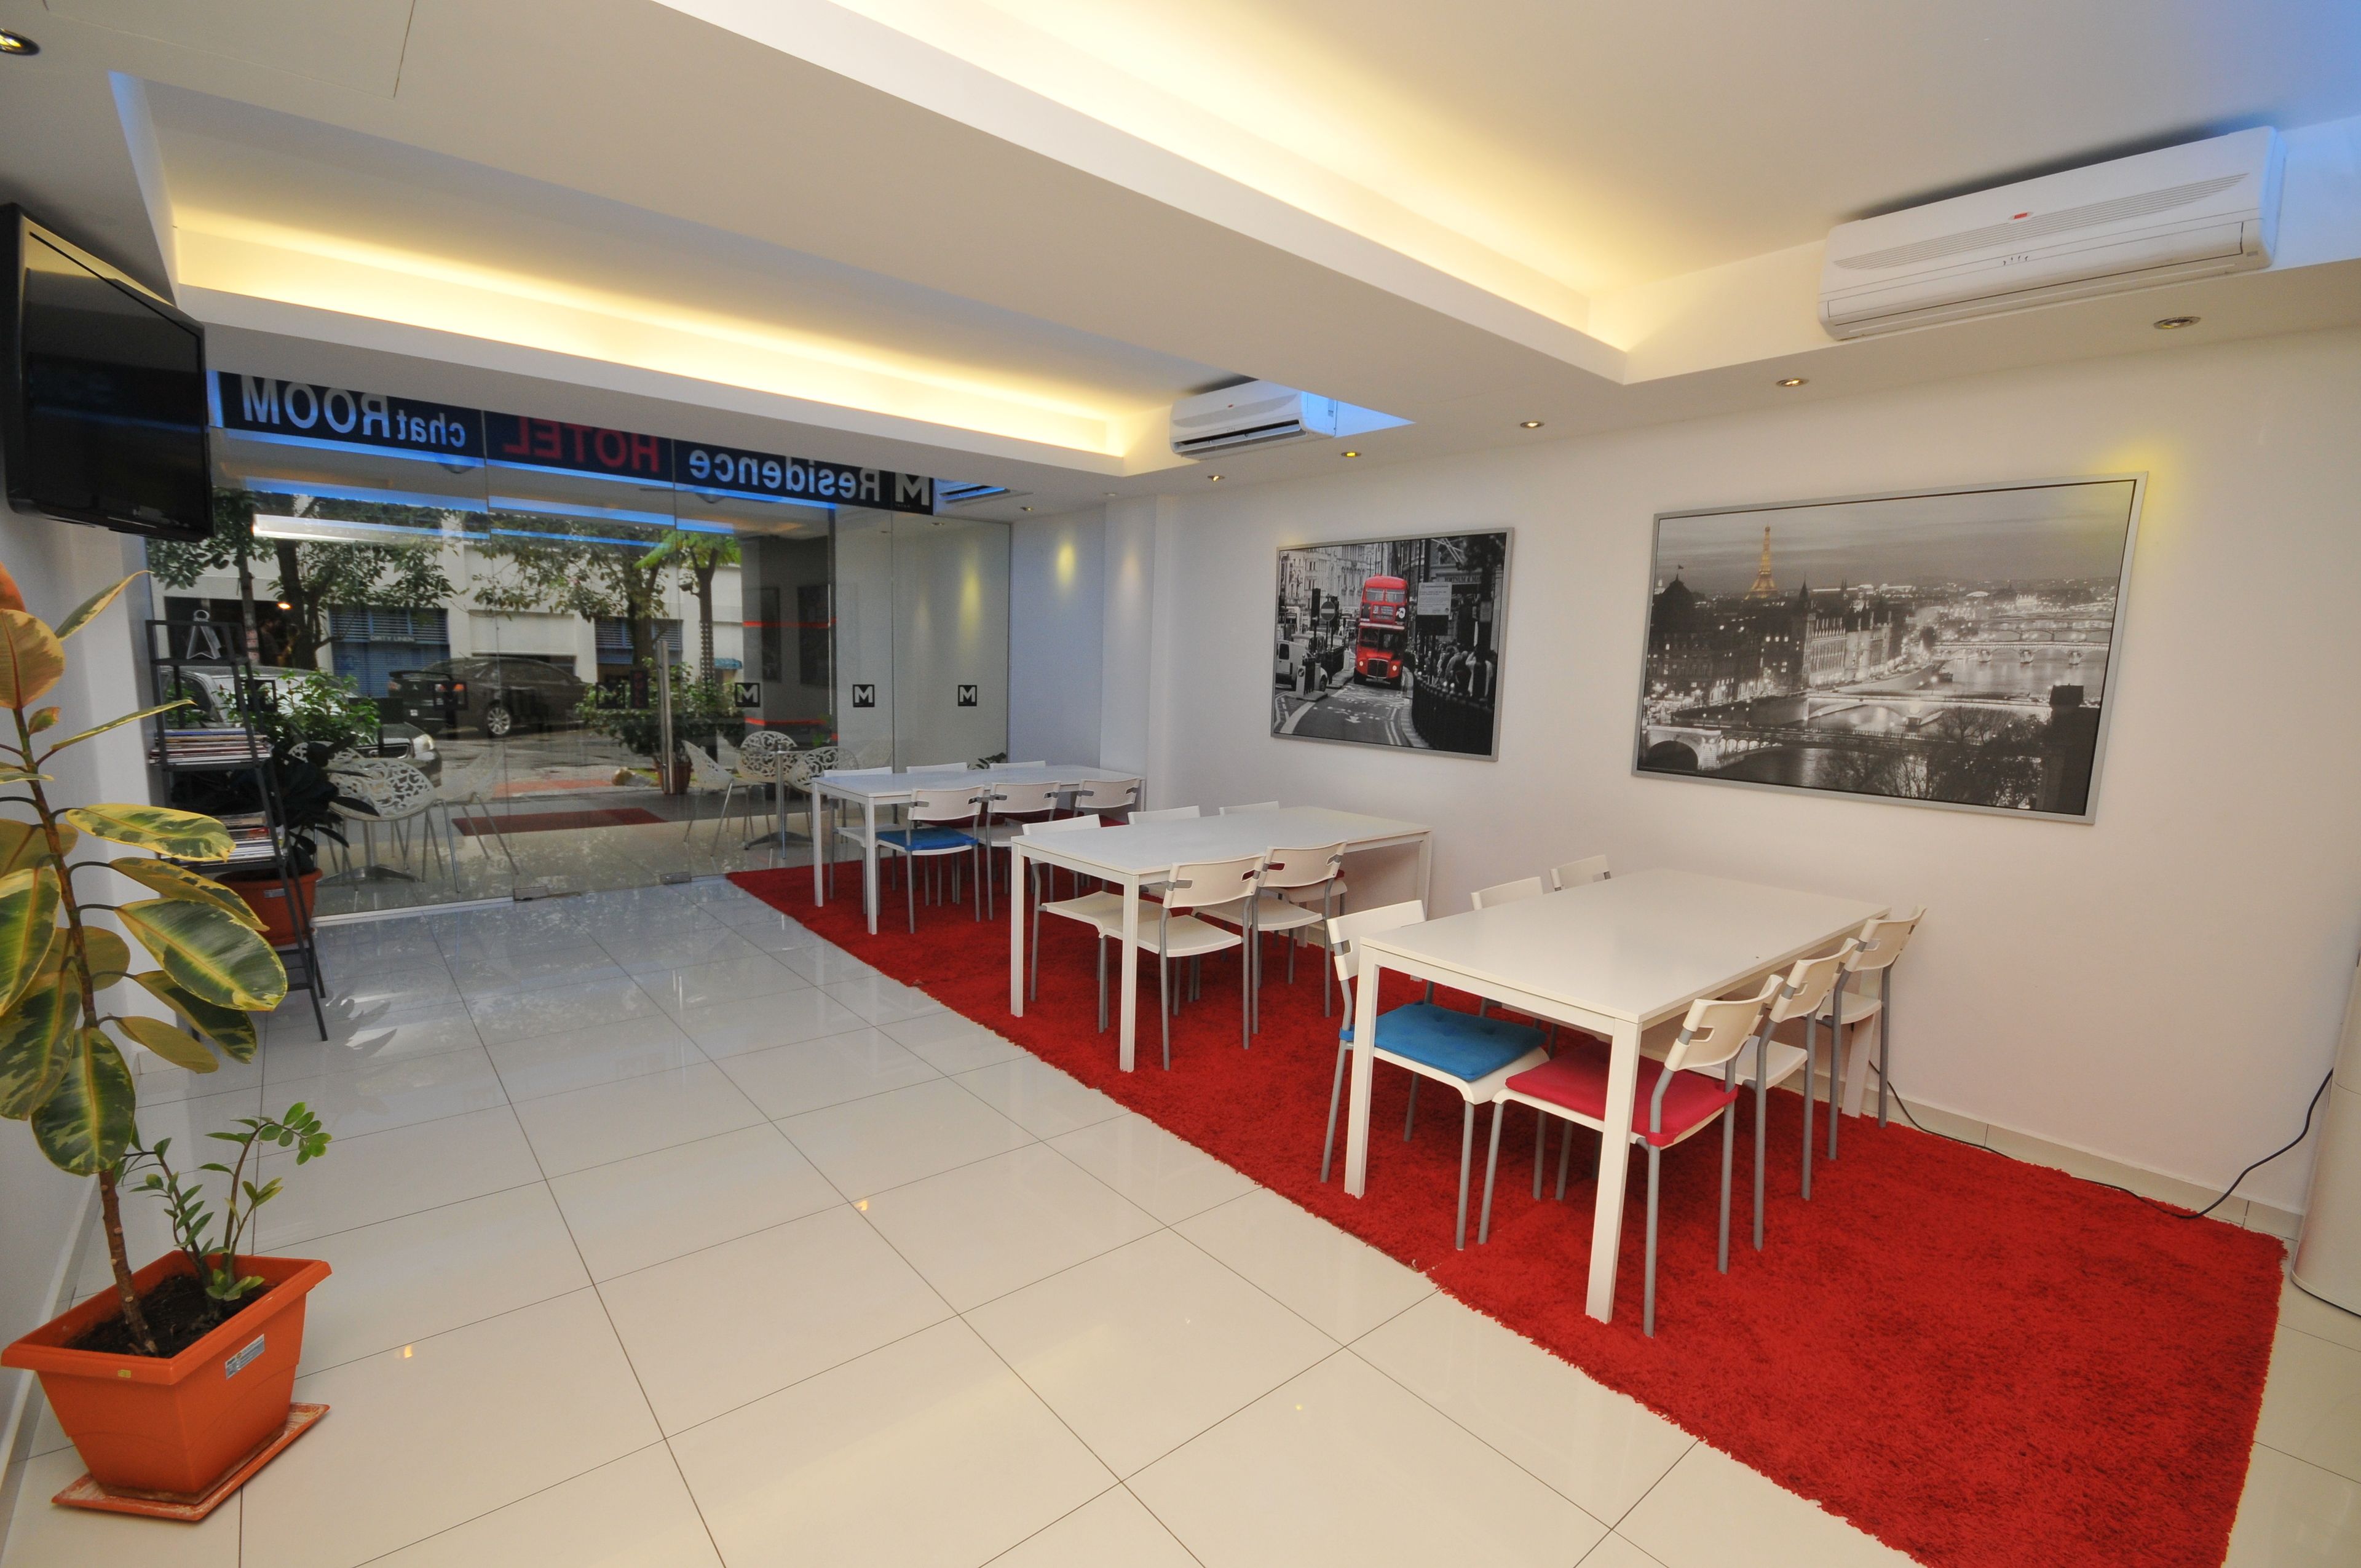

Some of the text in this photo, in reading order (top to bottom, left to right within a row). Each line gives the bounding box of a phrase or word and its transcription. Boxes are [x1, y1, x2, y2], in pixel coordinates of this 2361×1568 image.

[737, 684, 758, 703] M
[855, 686, 873, 703] M
[959, 686, 976, 703] M
